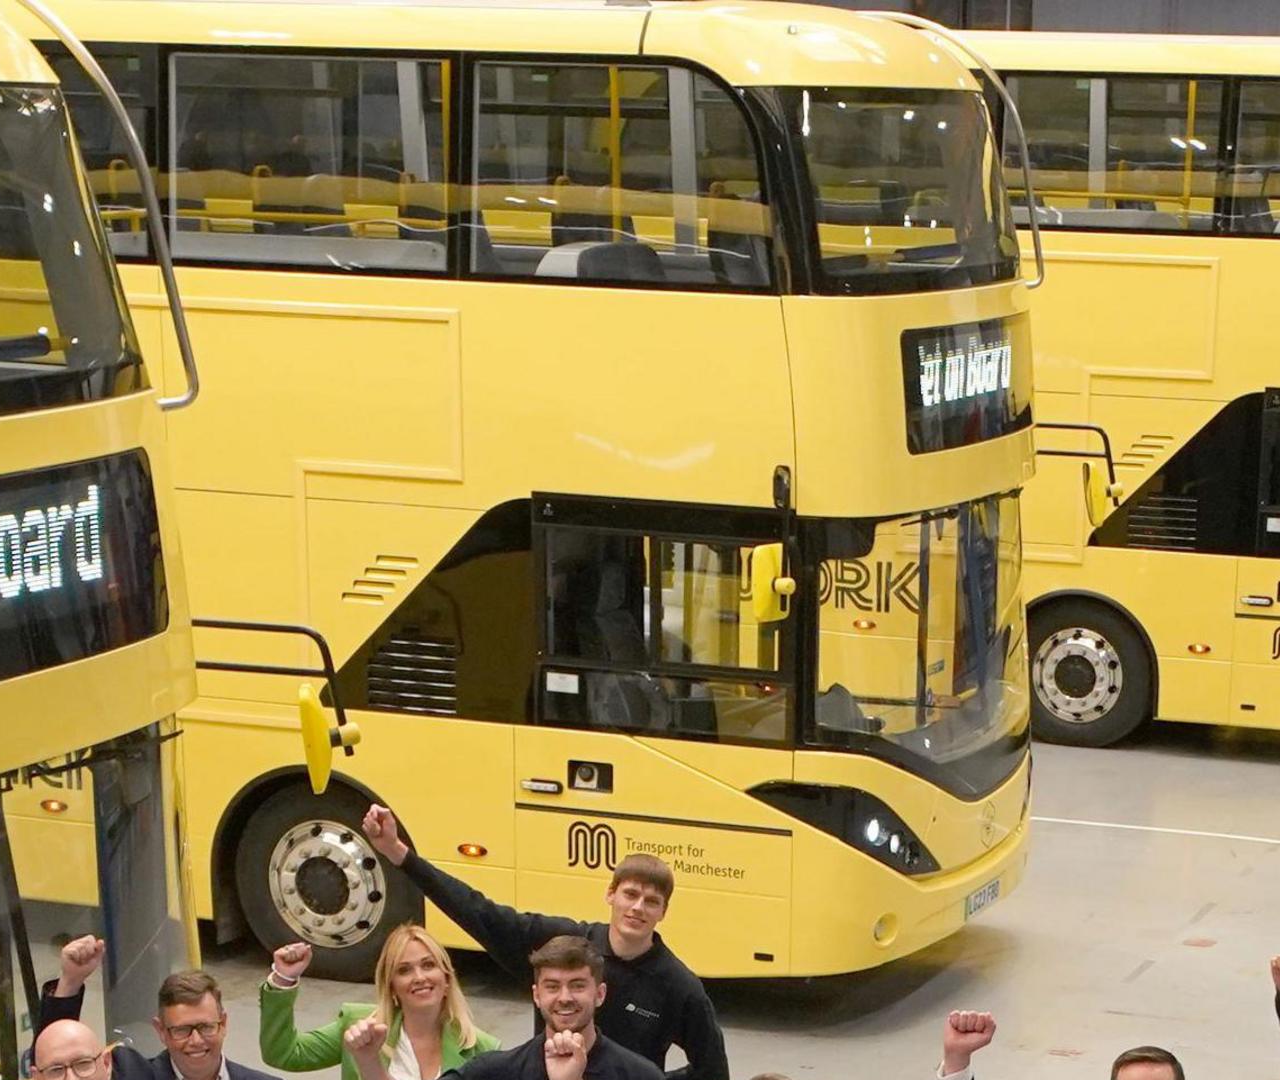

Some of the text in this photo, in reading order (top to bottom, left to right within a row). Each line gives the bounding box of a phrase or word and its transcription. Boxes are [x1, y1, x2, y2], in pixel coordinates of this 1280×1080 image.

[624, 837, 704, 857] Transport for
[673, 859, 746, 879] Manchester
